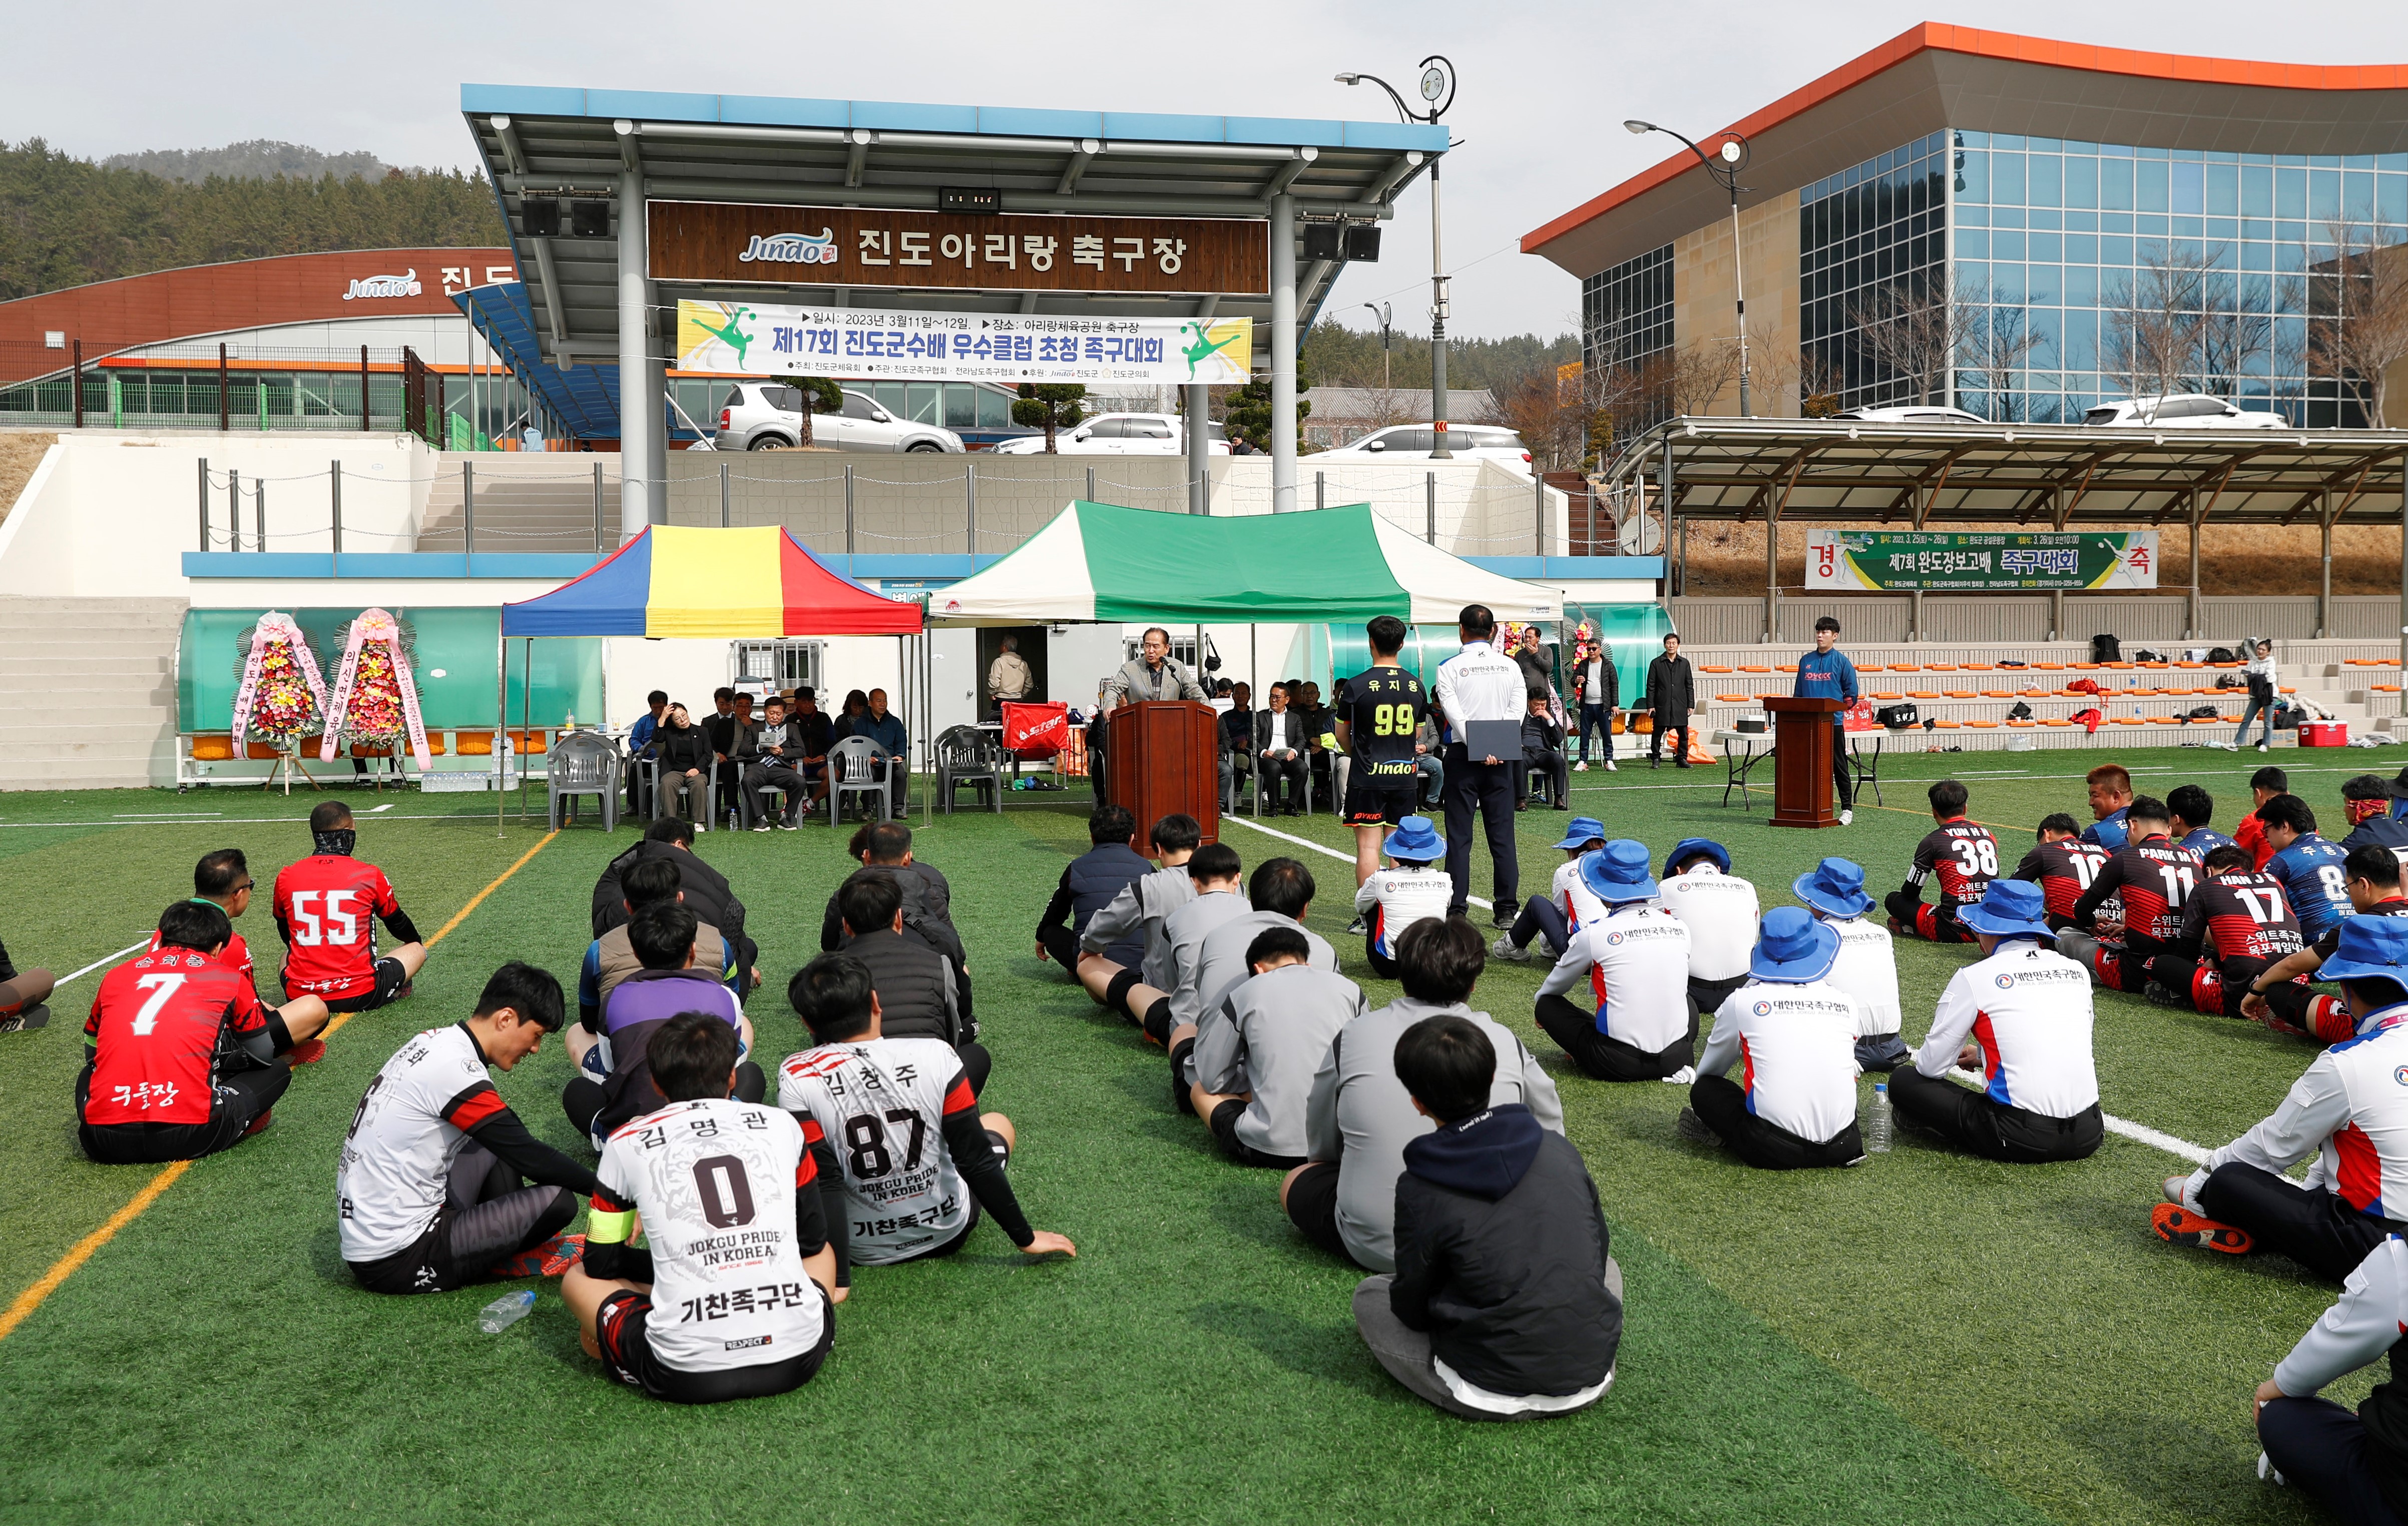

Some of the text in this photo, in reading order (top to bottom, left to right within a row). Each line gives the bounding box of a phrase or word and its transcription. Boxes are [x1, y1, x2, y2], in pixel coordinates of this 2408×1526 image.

[740, 236, 821, 262] Jindo
[859, 230, 1187, 274] 진도아리랑 축구장
[342, 279, 408, 300] Jindo
[813, 312, 971, 330] 일시: 2023년 3월11일~12일.
[993, 319, 1140, 334] 장소: 아리랑체육공원 축구장
[772, 327, 1163, 363] 제17회 진도군수배 우수클럽 초청 족구대회
[1077, 369, 1098, 378] 진도군
[1112, 370, 1150, 378] 진도군의회
[1880, 535, 1891, 544] 일시:
[1912, 535, 1927, 545] 25(토)
[1933, 534, 1949, 545] 26(일)
[1957, 536, 2005, 545] 장소: 완도군 공설운동장
[2017, 536, 2032, 545] 개회식:
[1810, 544, 1834, 577] 경
[1889, 549, 2078, 575] 제7회 완도장보고배 족구대회
[2127, 546, 2150, 575] 축
[324, 650, 355, 748] 의신면체육회
[1374, 704, 1414, 736] 99
[1368, 762, 1412, 776] Jindo
[1354, 812, 1382, 821] JOYKICK
[1945, 828, 1971, 837] YUN
[1951, 839, 1998, 876] 38
[2062, 842, 2104, 853] BJ KIM
[2139, 848, 2176, 862] PARK
[1397, 881, 1446, 889] 대한민국족구협회
[1691, 882, 1746, 891] 대한민국족구협회
[2159, 865, 2195, 907] 11
[2219, 875, 2252, 886] HAN
[2317, 865, 2349, 902] 8
[2233, 887, 2284, 924] 17
[291, 890, 360, 946] 55
[1624, 927, 1685, 938] 대한민국족구협회
[2245, 930, 2303, 945] 스위트족구단
[2013, 969, 2084, 981] 대한민국족구협회
[130, 972, 189, 1036] 7
[1773, 1000, 1849, 1015] 대한민국족구협회
[823, 1063, 918, 1096] 김창주
[111, 1081, 180, 1110] 구들장
[639, 1111, 768, 1150] 김명관
[844, 1107, 926, 1181] 87
[859, 1163, 939, 1194] JOKGU PRIDE
[691, 1153, 758, 1230] 0
[873, 1192, 887, 1202] IN
[853, 1194, 957, 1237] 기찬족구단
[688, 1231, 781, 1256] JOKGU PRIDE
[703, 1254, 720, 1266] IN
[681, 1282, 803, 1323] 기찬족구단
[726, 1337, 764, 1350] RESPECT
